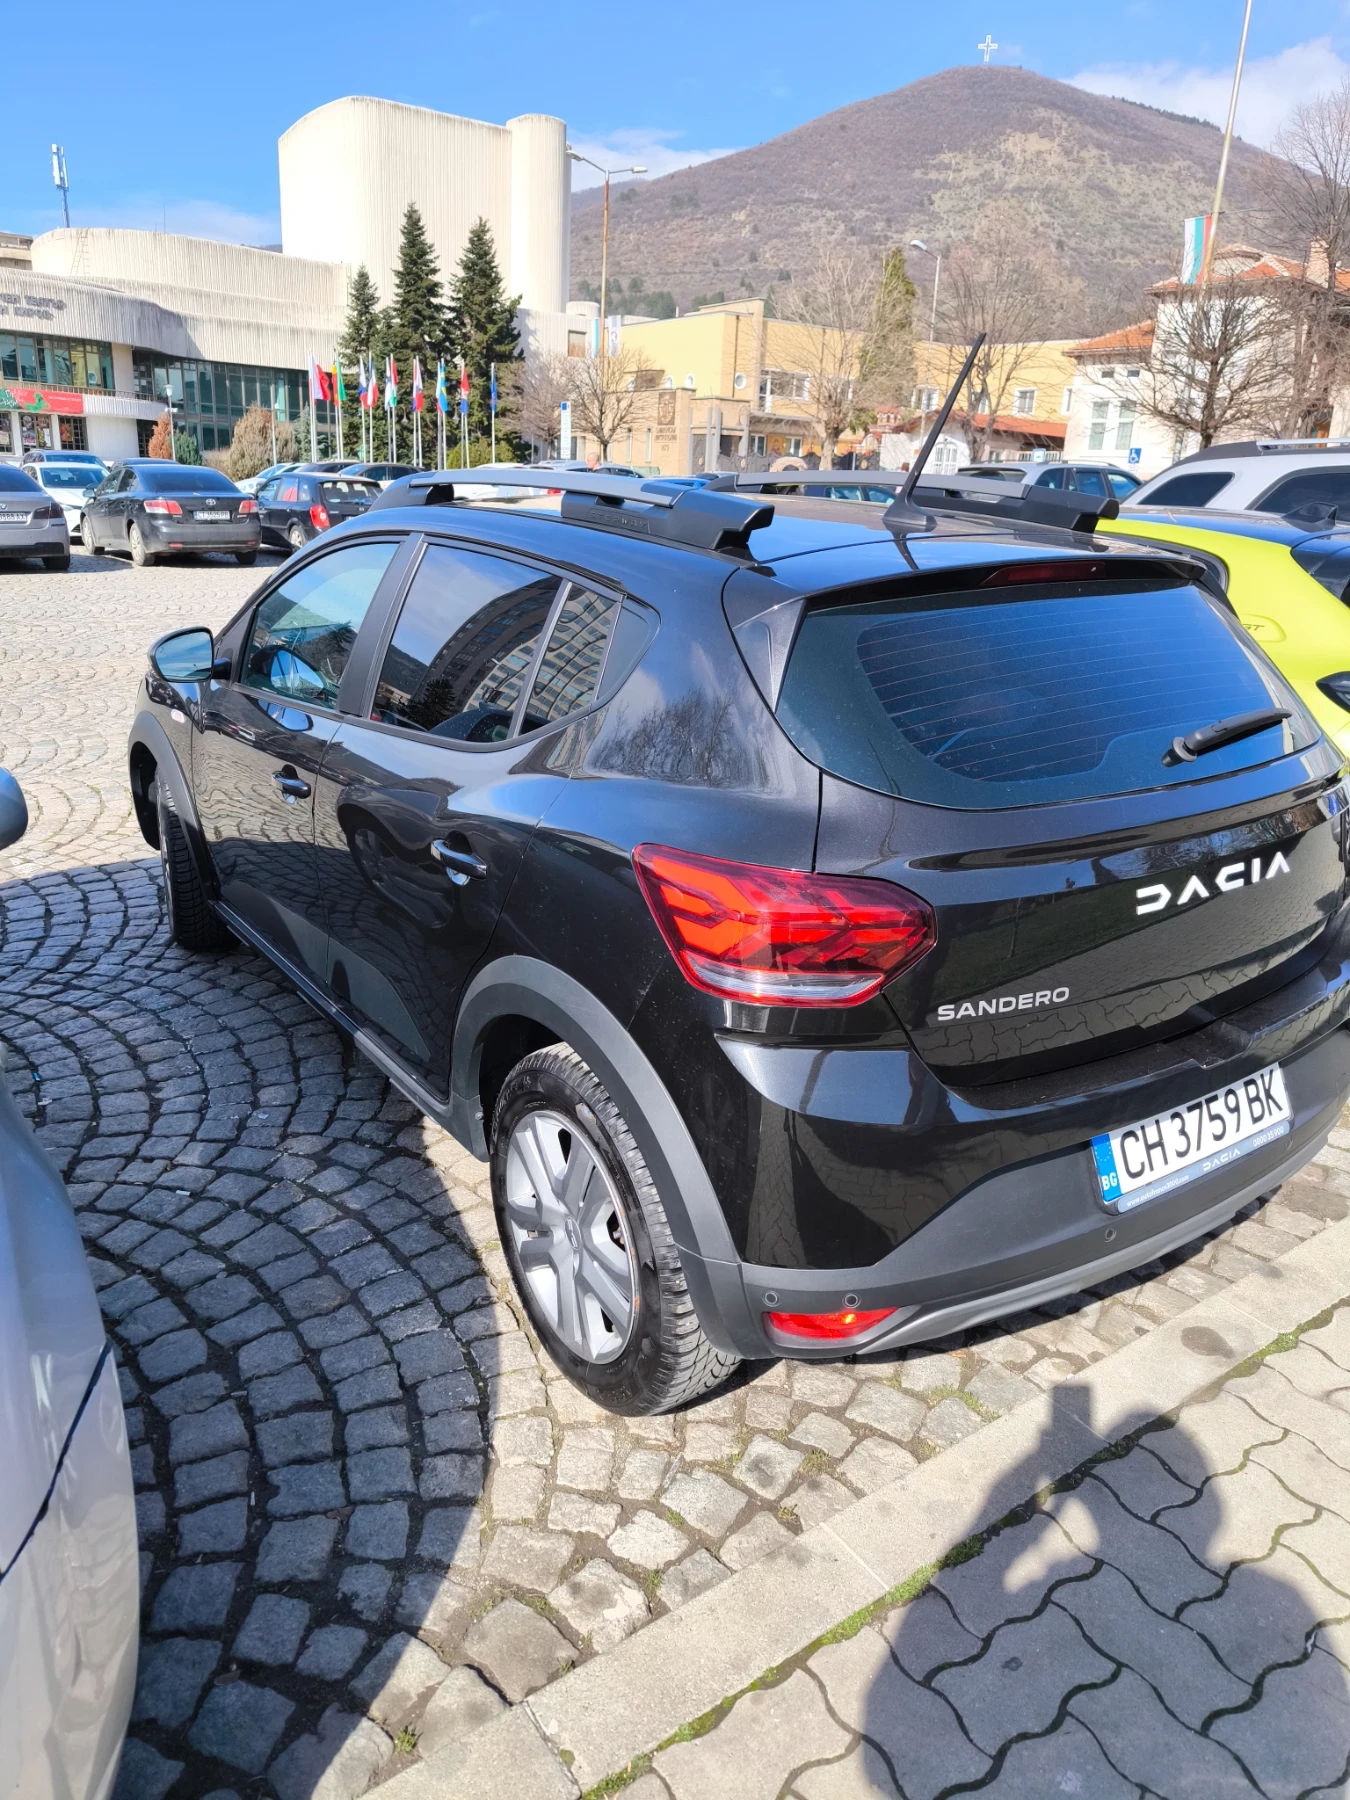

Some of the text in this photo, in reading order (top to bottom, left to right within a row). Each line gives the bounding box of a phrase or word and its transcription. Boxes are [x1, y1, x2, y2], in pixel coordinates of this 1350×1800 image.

[1136, 851, 1291, 915] DACIA
[937, 987, 1070, 1021] SANDERO
[1119, 1069, 1283, 1179] CH 3759 BK
[1202, 1148, 1241, 1172] DACIA
[1101, 1172, 1118, 1190] BG
